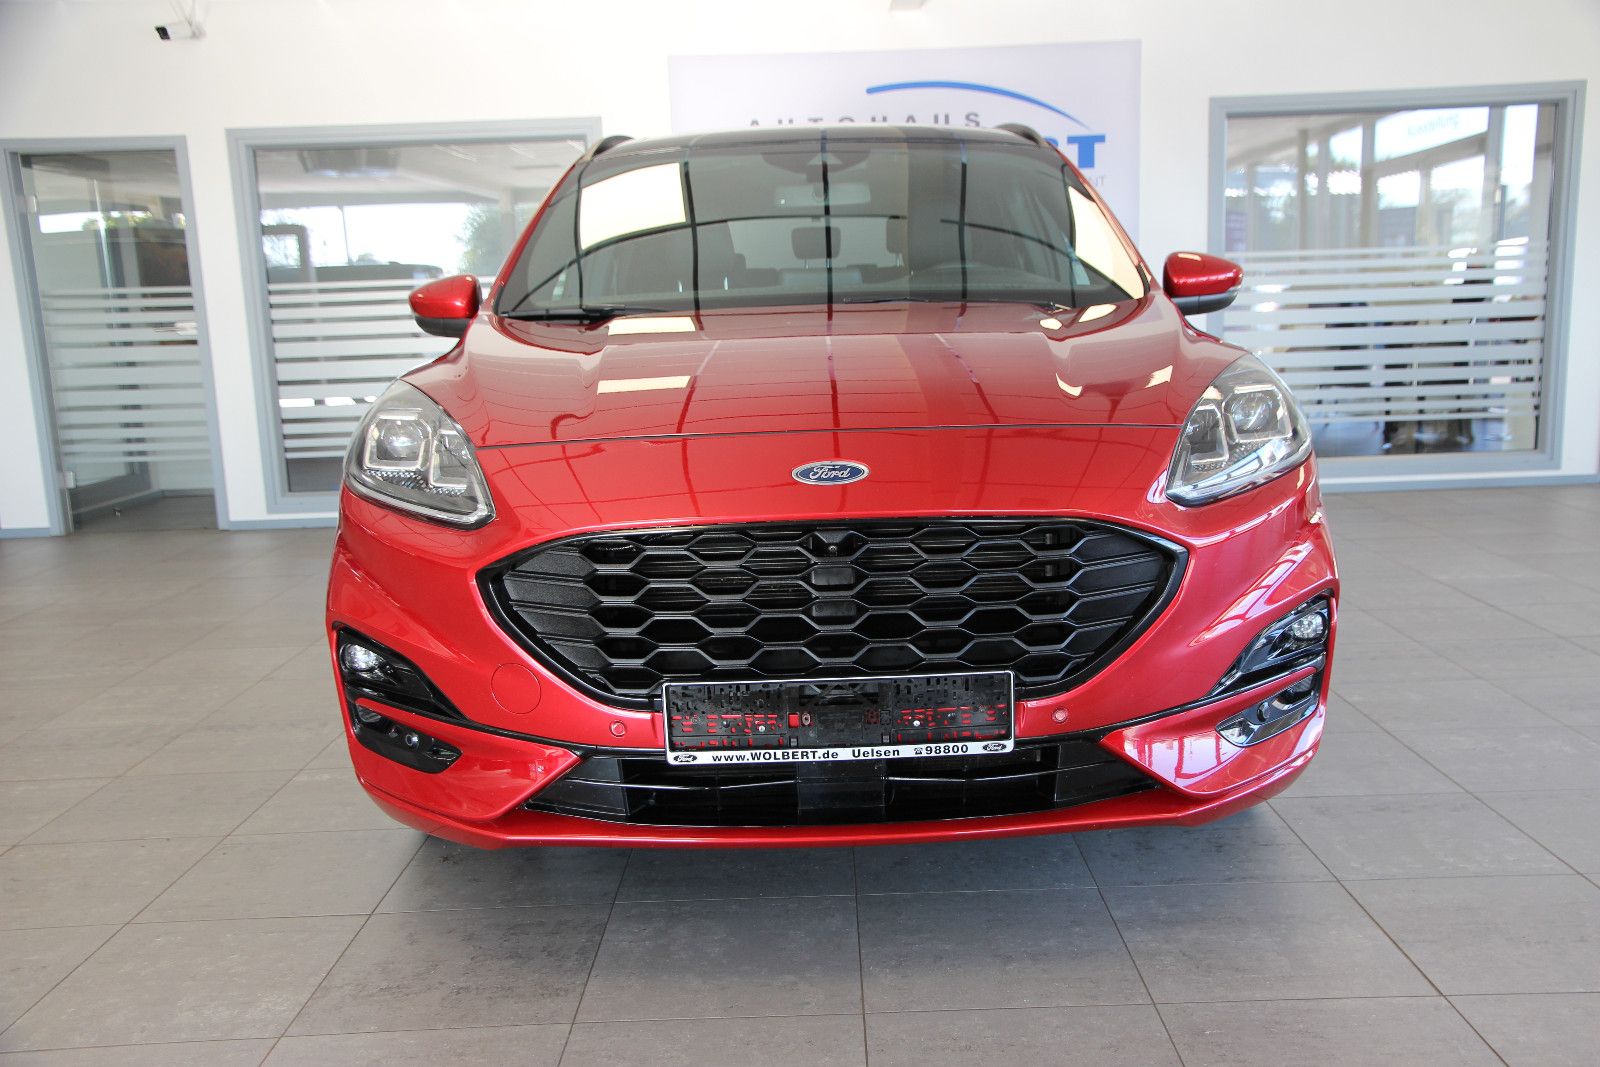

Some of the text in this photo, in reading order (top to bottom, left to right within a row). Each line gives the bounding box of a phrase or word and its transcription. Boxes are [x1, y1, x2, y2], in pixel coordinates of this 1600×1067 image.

[808, 464, 851, 480] Ford
[711, 743, 969, 762] www.WOLBERT.de Uelsen 98800
